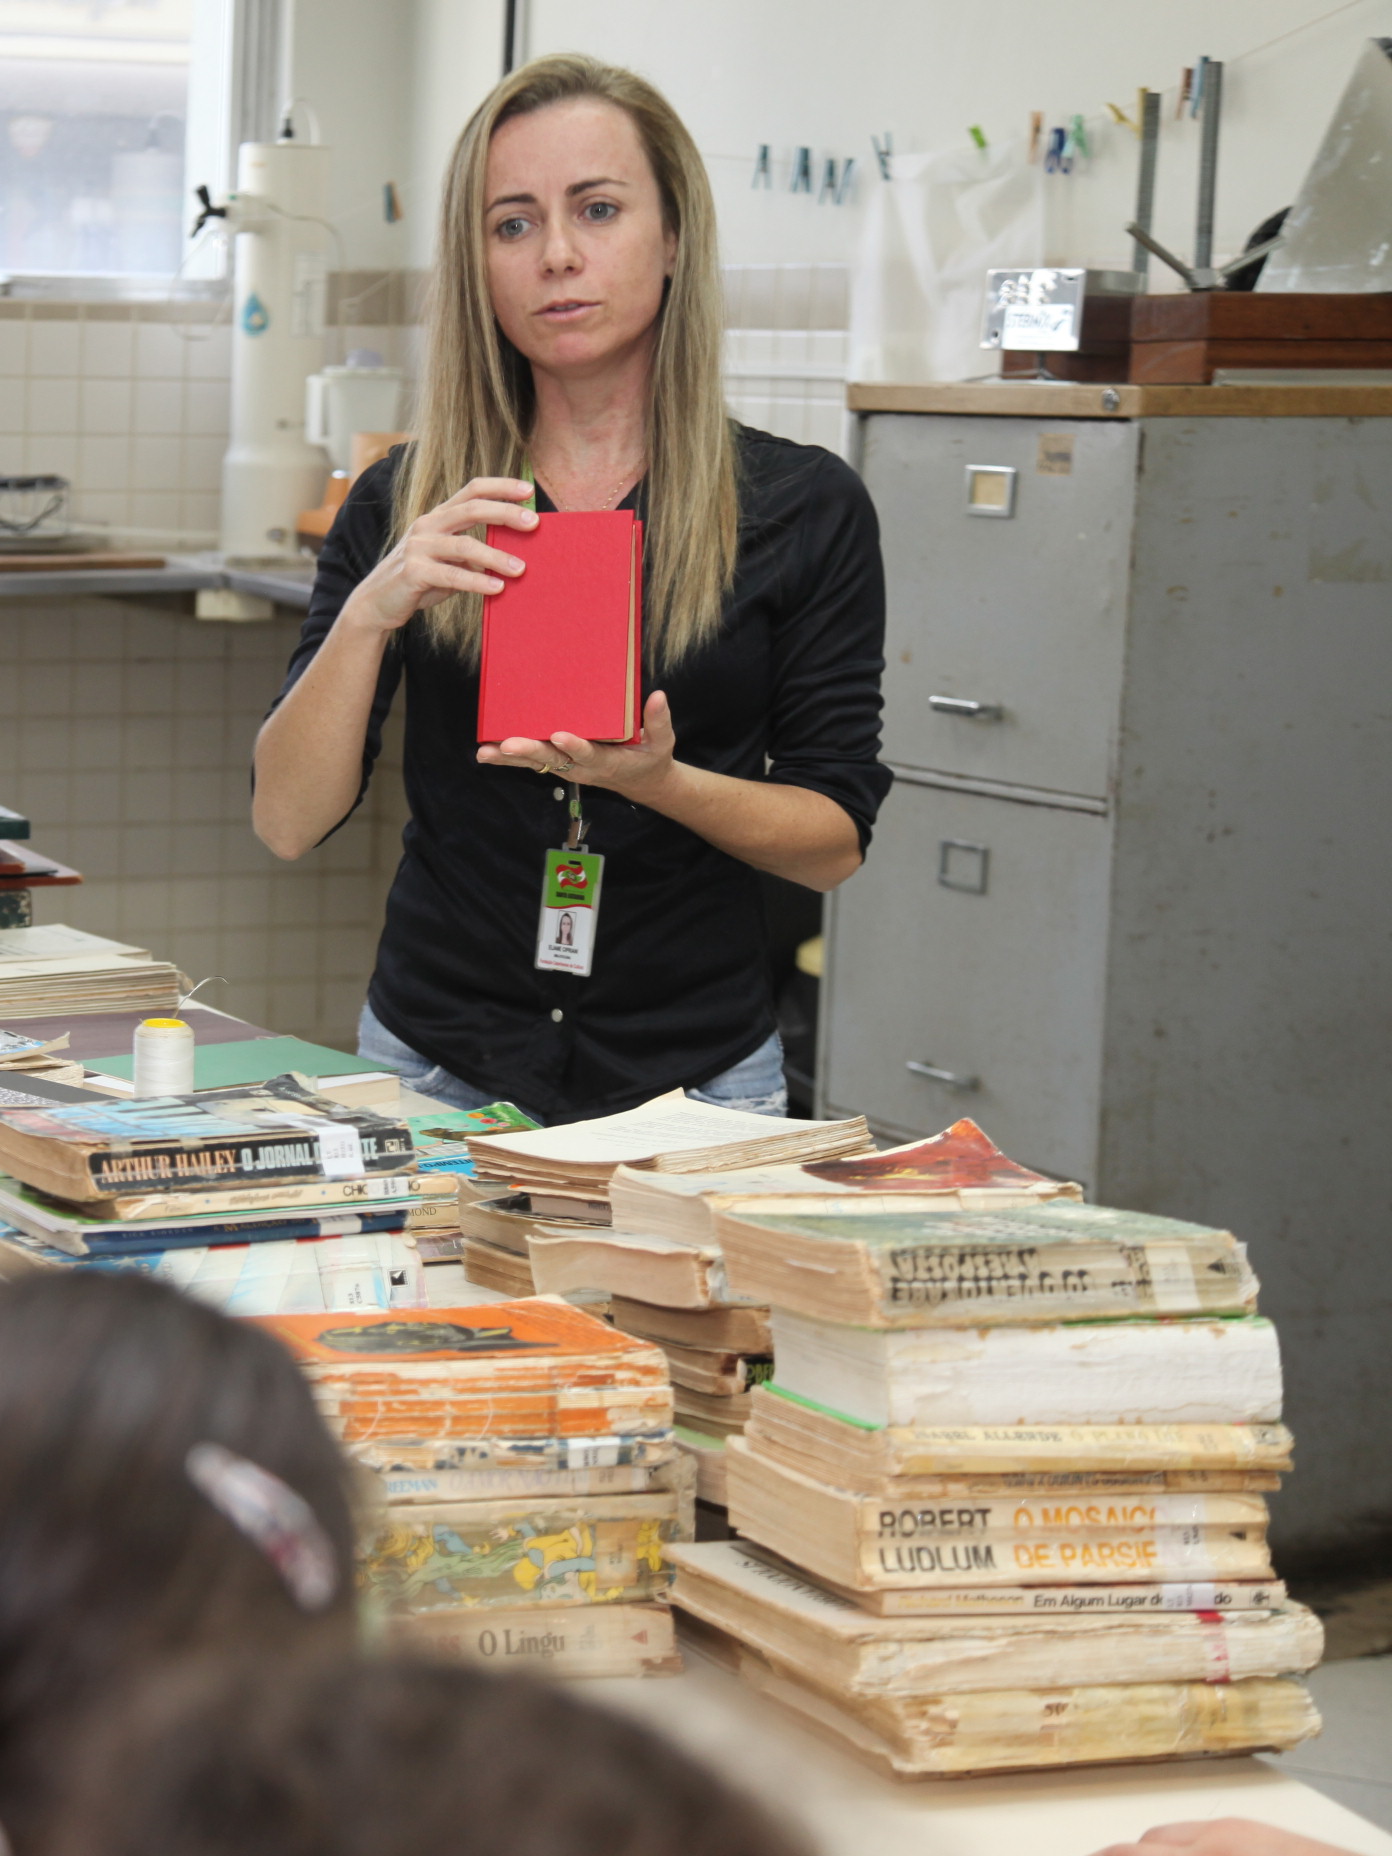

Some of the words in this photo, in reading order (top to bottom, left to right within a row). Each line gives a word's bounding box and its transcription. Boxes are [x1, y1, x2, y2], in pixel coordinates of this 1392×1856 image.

[102, 1153, 173, 1184] ARTHUR
[175, 1149, 237, 1178] HAILEY
[241, 1148, 253, 1171] O
[256, 1143, 313, 1170] JORNAL
[343, 1183, 368, 1197] CHIC
[408, 1207, 437, 1217] MOND
[386, 1478, 439, 1494] REEMAN
[878, 1508, 992, 1538] ROBERT
[879, 1545, 997, 1573] LUDLUM
[1013, 1543, 1056, 1569] DE
[1059, 1540, 1158, 1568] PARSIF
[1034, 1595, 1057, 1608] Em
[1060, 1594, 1105, 1611] Algum
[1108, 1594, 1148, 1609] Lugar
[478, 1629, 498, 1657] O
[504, 1628, 566, 1659] Lingu
